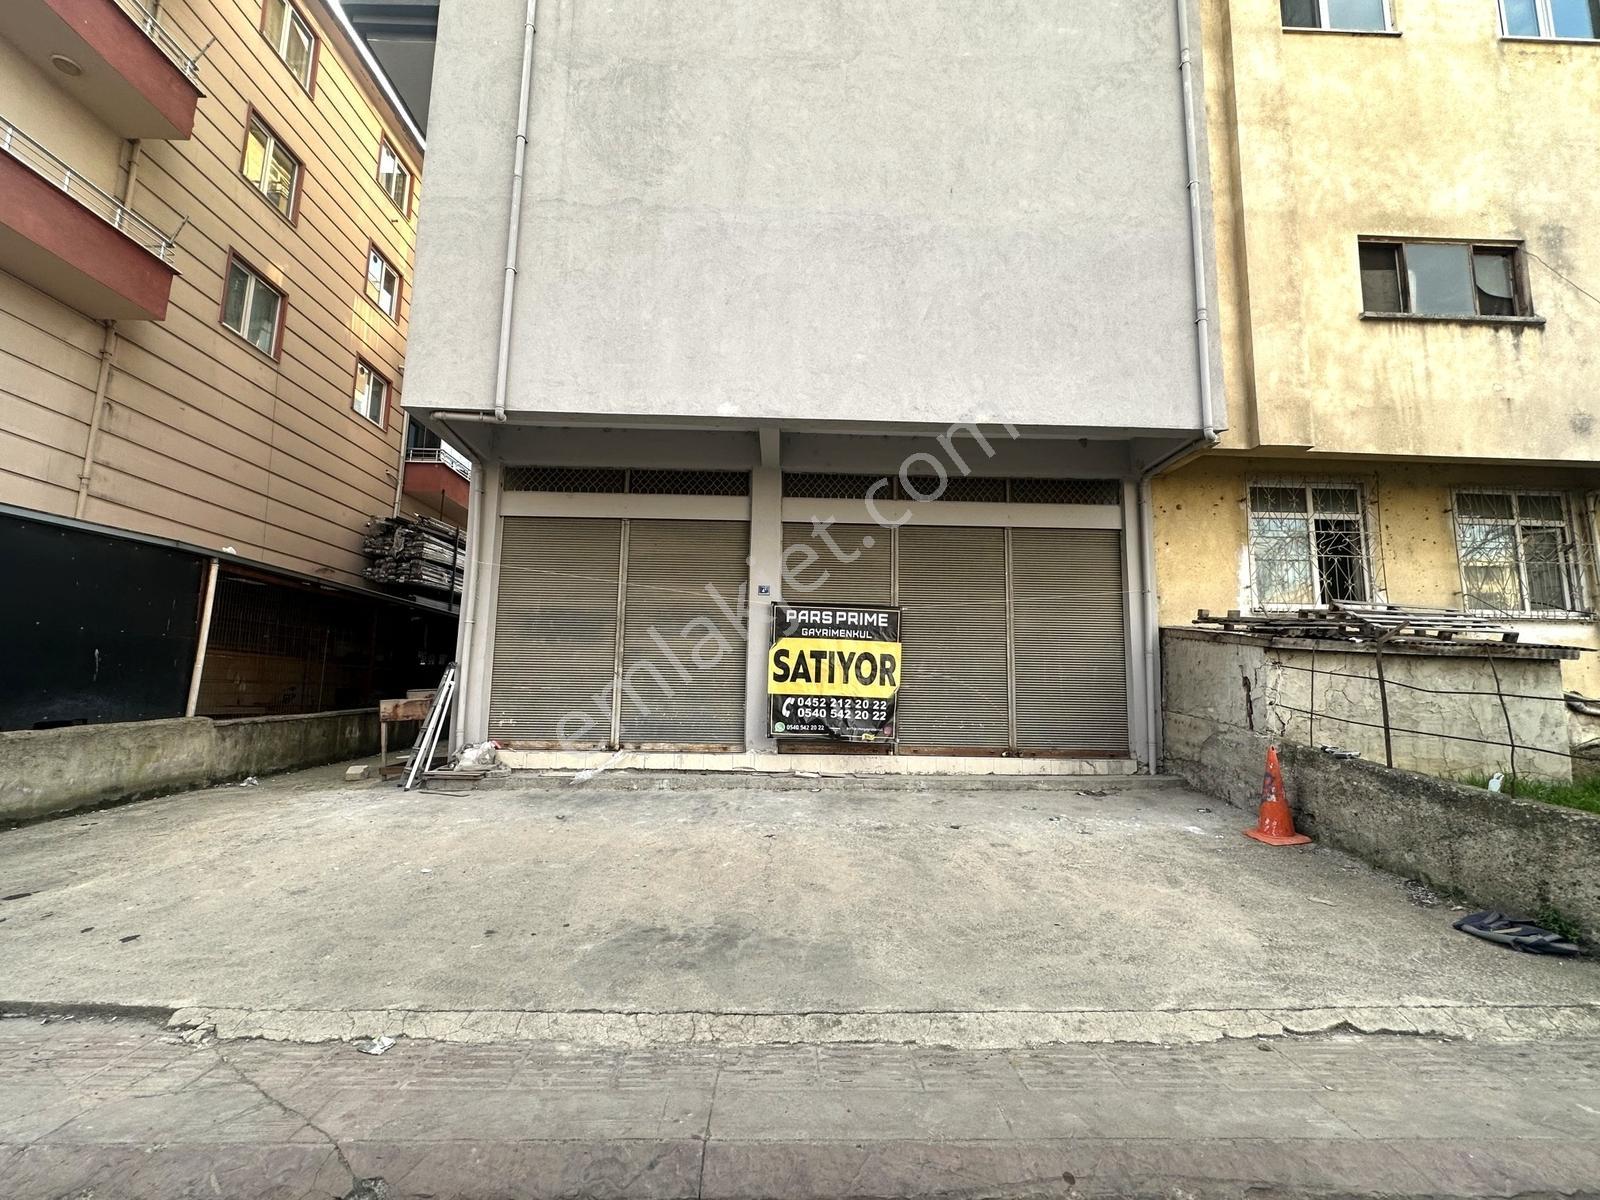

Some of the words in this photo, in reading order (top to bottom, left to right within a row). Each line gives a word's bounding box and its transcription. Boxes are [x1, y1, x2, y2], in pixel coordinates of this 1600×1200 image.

[786, 610, 833, 624] PARS
[835, 612, 889, 626] PRIME
[801, 627, 873, 639] GAYRİMENKUL
[773, 649, 896, 686] SATIYOR
[797, 697, 826, 707] 0452
[830, 699, 851, 708] 212
[855, 700, 869, 709] 20
[873, 701, 887, 710] 22
[797, 708, 827, 718] 0540
[830, 709, 851, 719] 542
[855, 710, 869, 720] 20
[872, 711, 887, 721] 22
